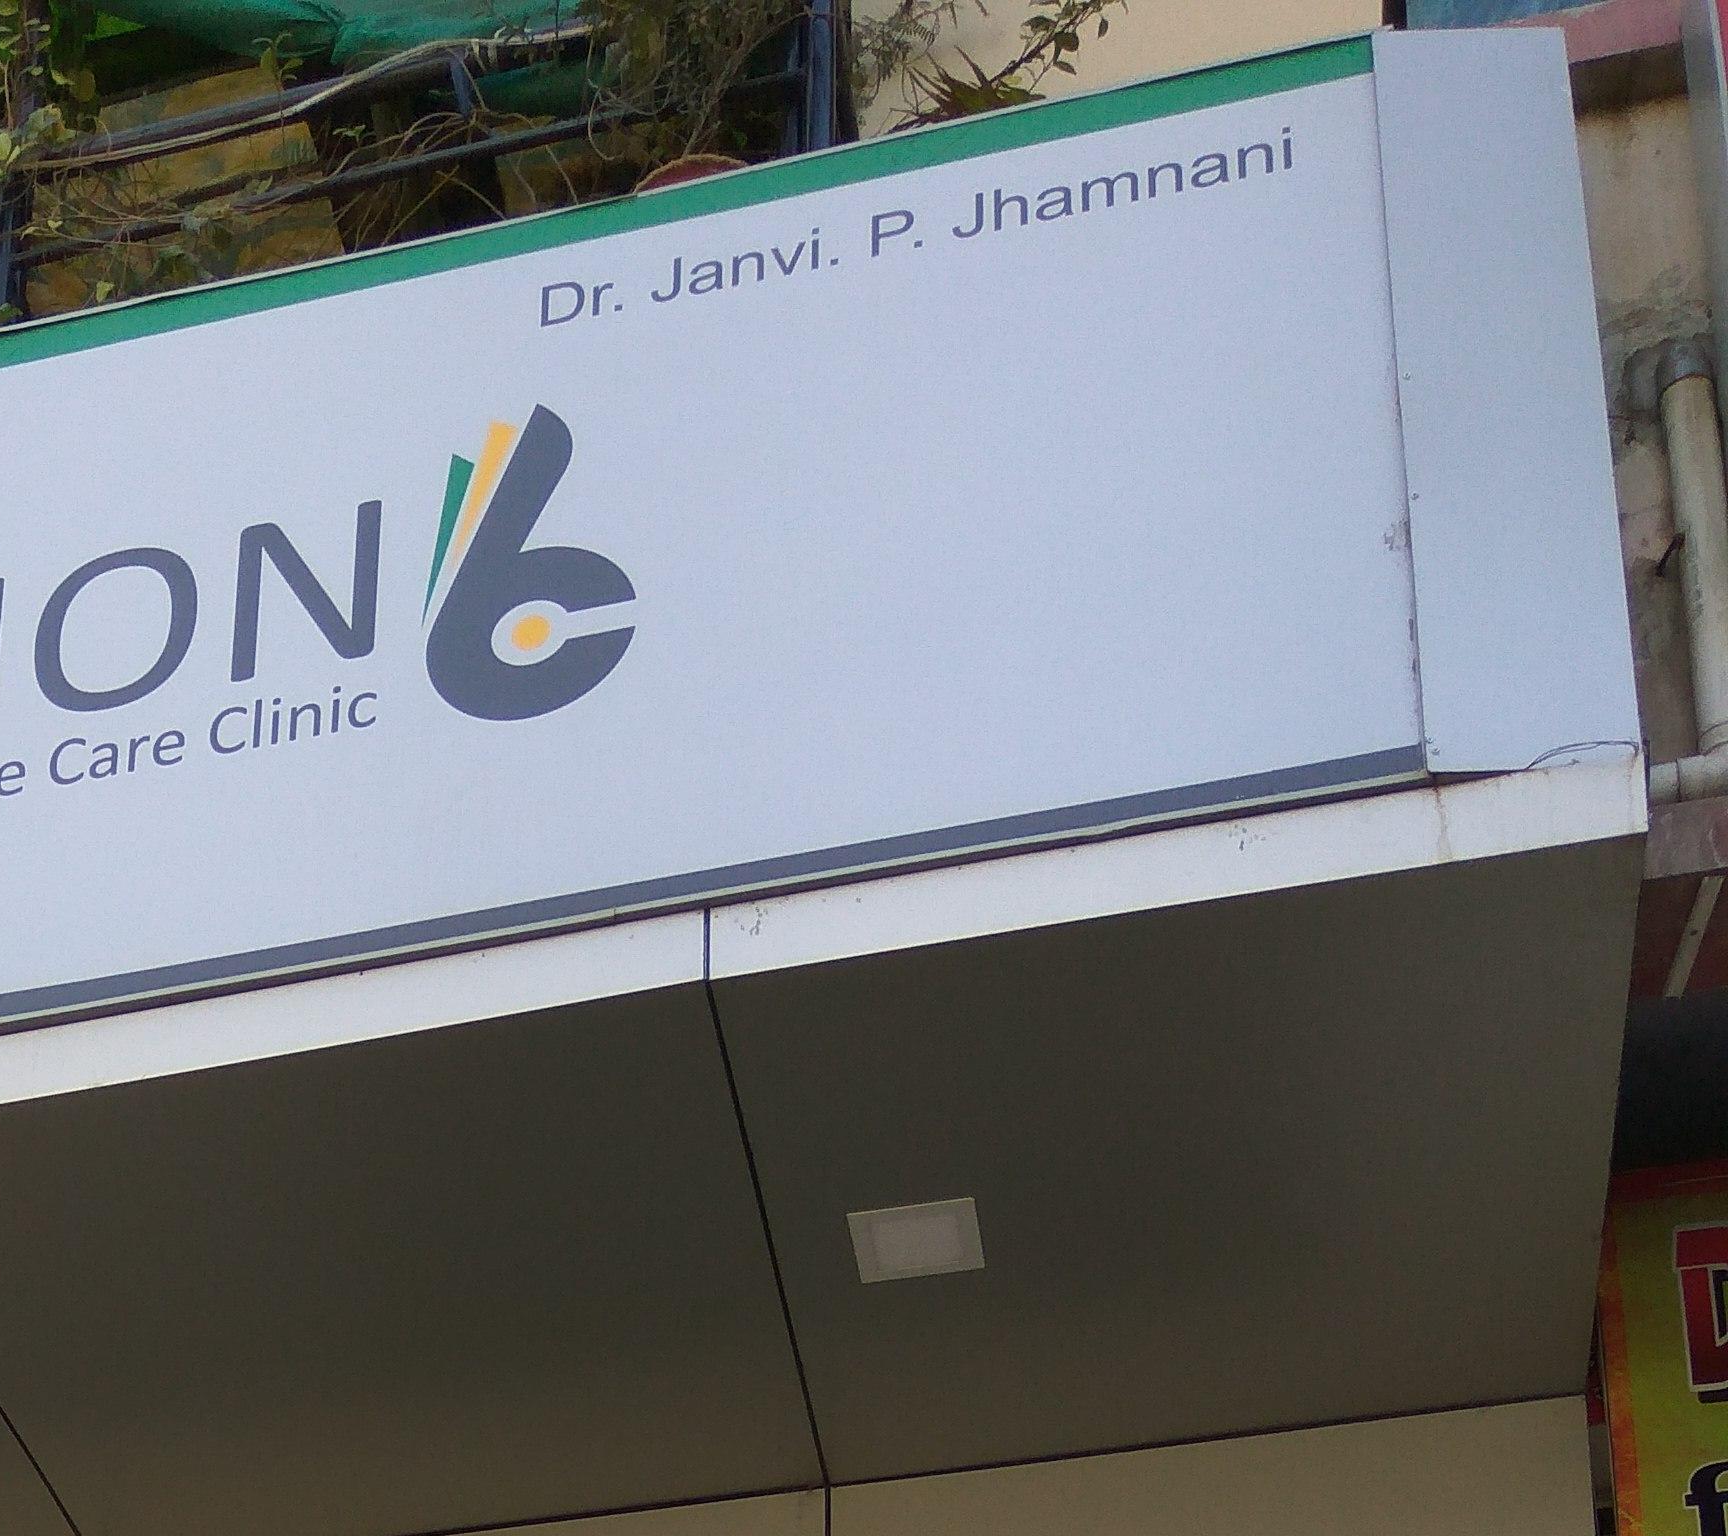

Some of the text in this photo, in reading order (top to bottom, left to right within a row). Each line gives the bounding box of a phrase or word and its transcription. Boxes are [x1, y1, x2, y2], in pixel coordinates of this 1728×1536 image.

[539, 125, 1295, 328] Dr. Janvi. P. Jhamnani
[48, 728, 186, 786] Care
[208, 684, 378, 756] Clinic
